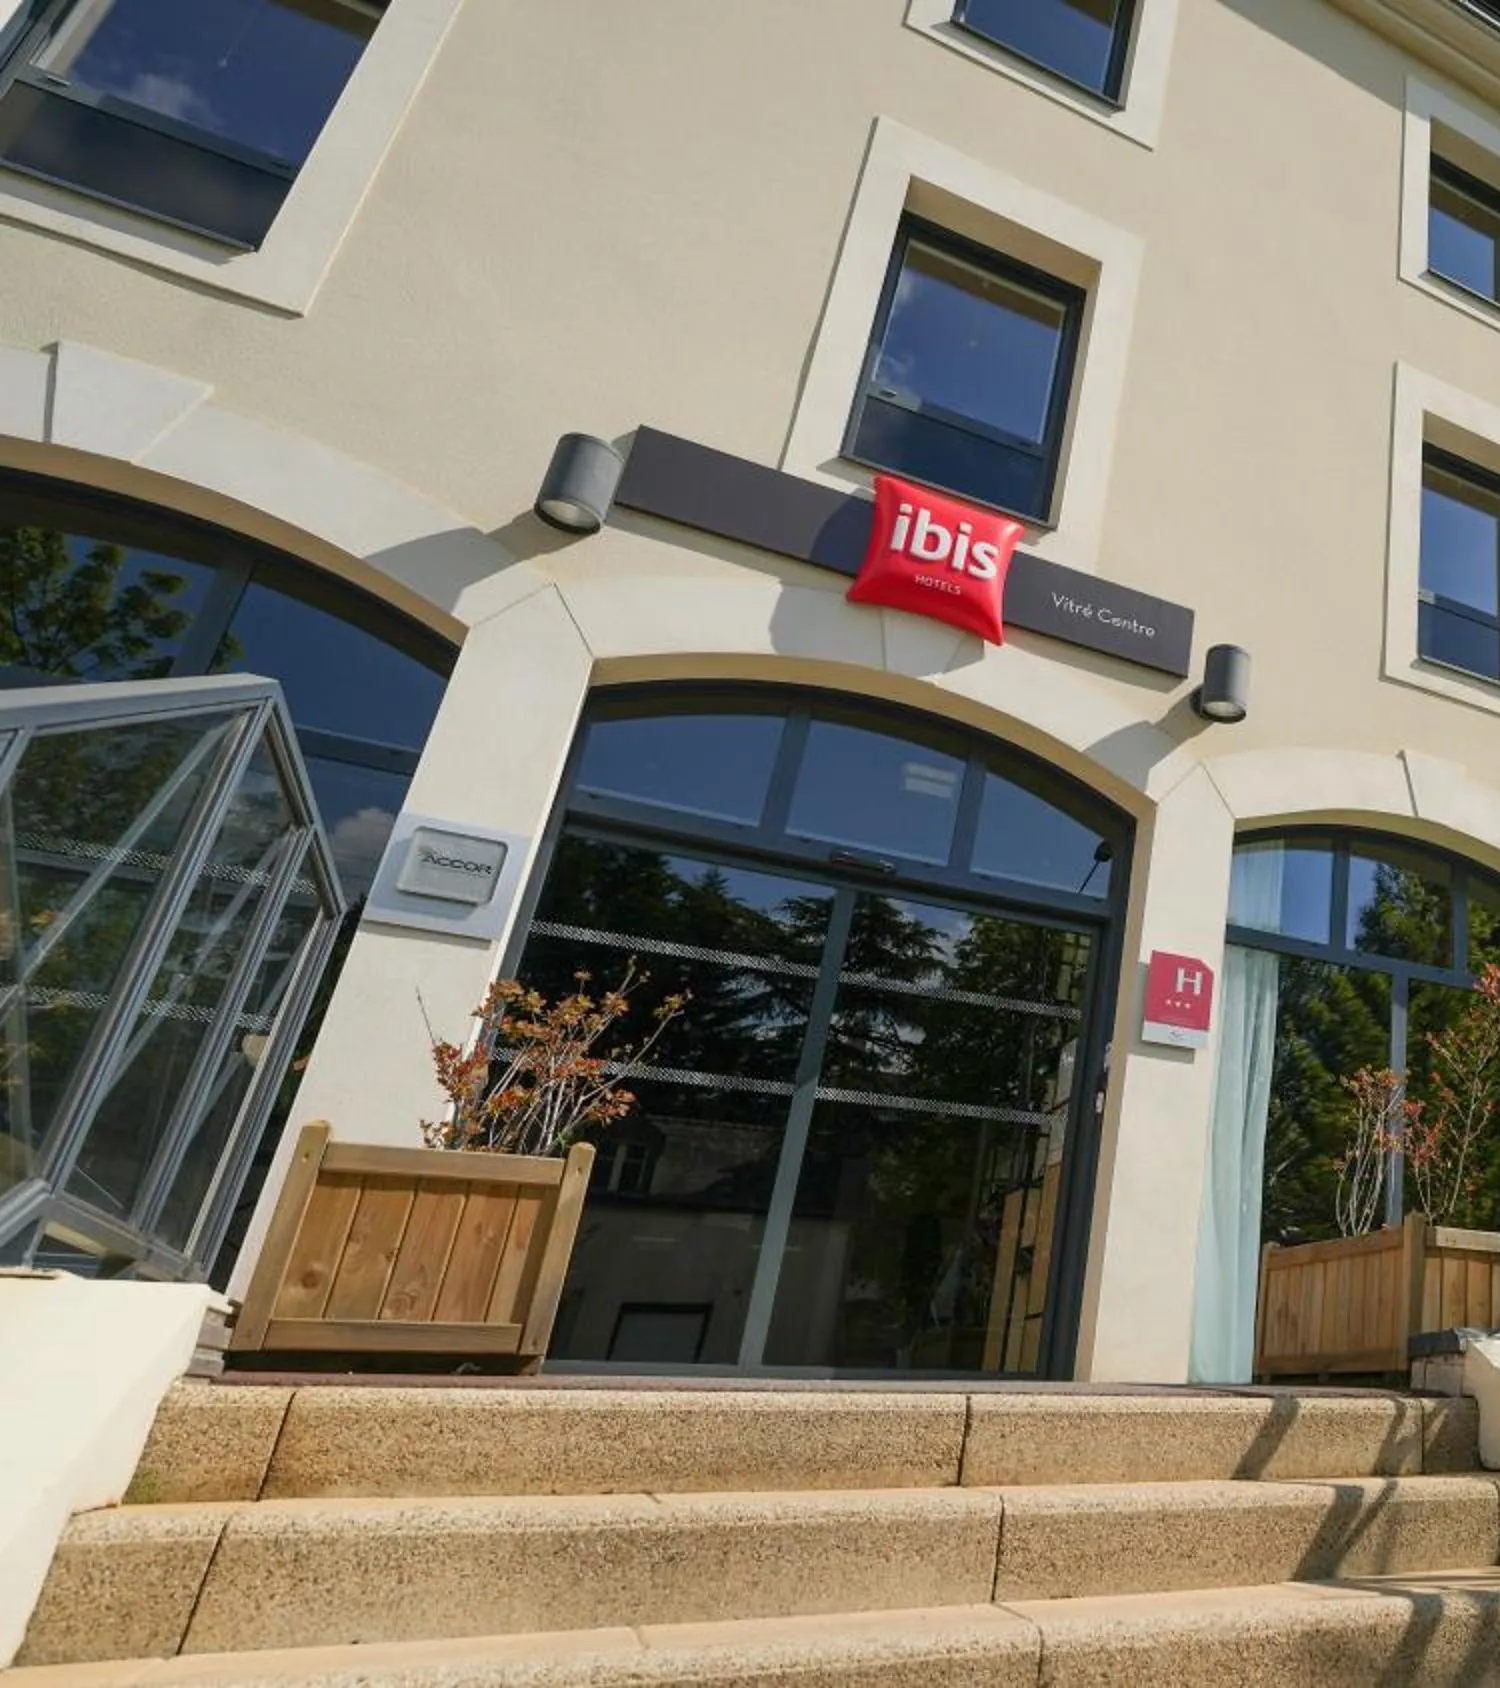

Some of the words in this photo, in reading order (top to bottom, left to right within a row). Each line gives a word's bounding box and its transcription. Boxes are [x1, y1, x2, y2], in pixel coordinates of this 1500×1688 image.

[890, 503, 999, 580] ibis
[914, 574, 961, 595] HOTELS
[1051, 591, 1093, 618] Vitré
[1097, 607, 1156, 637] Centre
[421, 854, 492, 875] ACCOR
[1176, 967, 1202, 996] H
